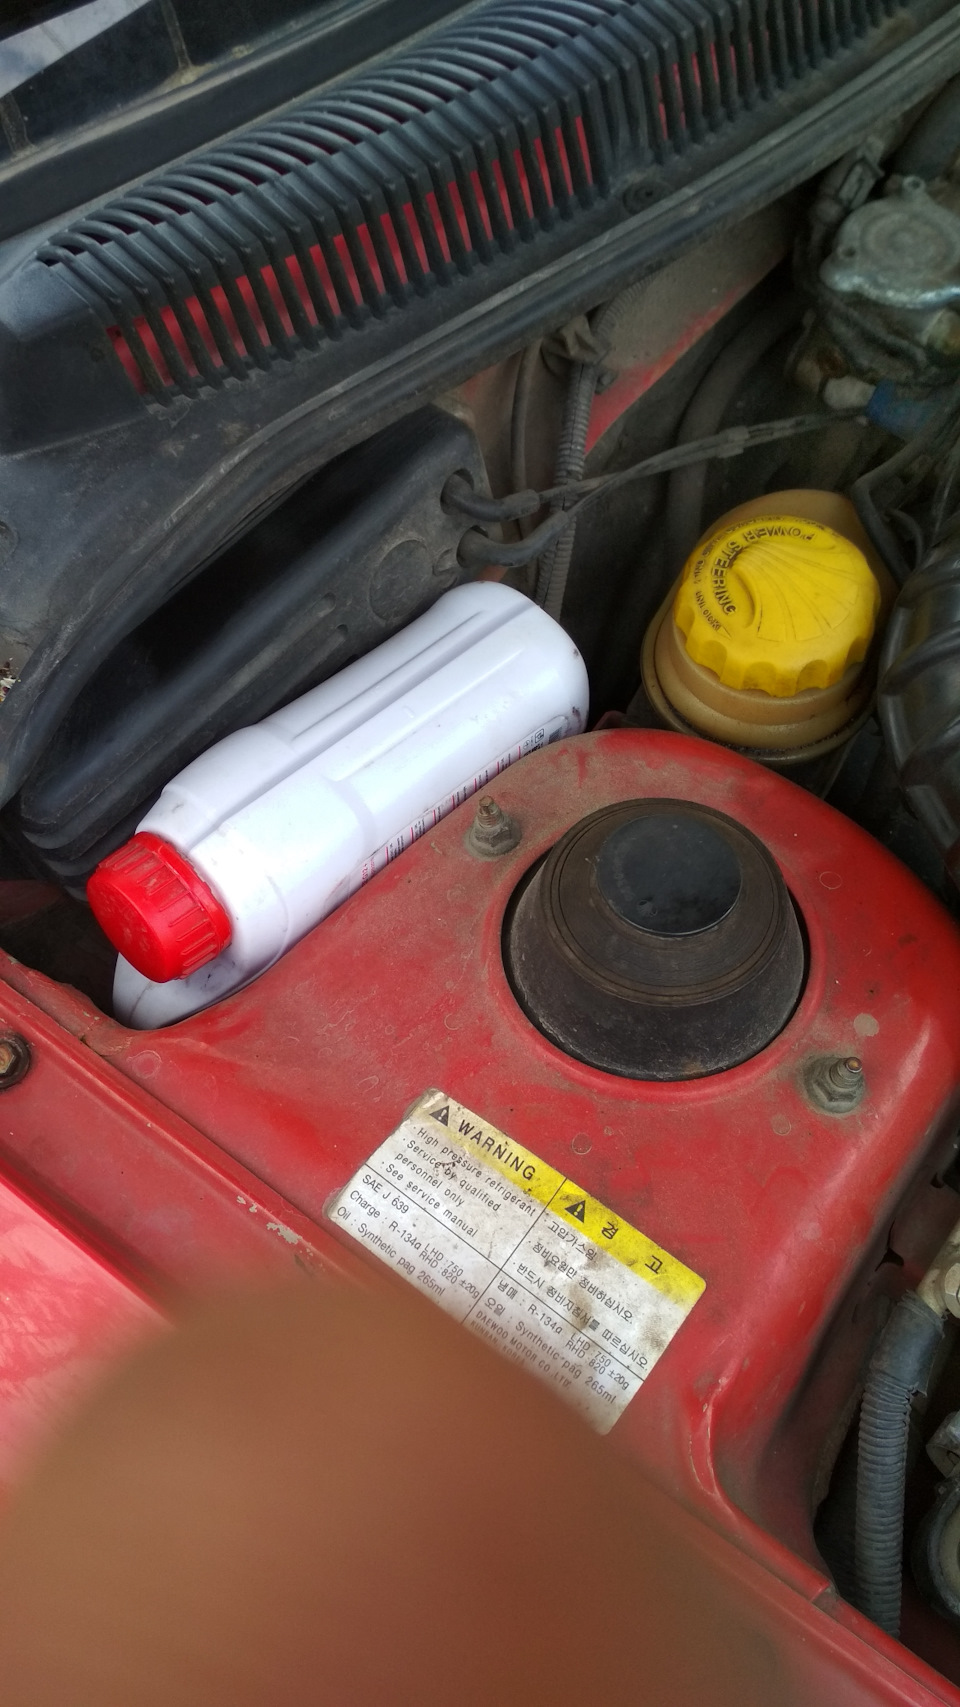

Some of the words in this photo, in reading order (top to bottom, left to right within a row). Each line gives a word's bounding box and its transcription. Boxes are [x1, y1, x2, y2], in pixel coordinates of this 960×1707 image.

[743, 526, 814, 541] POWER
[711, 541, 741, 616] STEERING
[407, 1140, 441, 1168] Service
[445, 1167, 455, 1180] by
[460, 1179, 500, 1211] qualified
[417, 1128, 439, 1148] High
[440, 1147, 482, 1177] pressure
[485, 1176, 536, 1216] refrigerant
[457, 1119, 537, 1180] WARNING
[362, 1174, 382, 1193] SAE
[383, 1190, 390, 1199] J
[391, 1196, 409, 1214] 639
[386, 1164, 404, 1181] See
[407, 1181, 440, 1209] service
[443, 1209, 478, 1237] manual
[395, 1153, 442, 1188] personnel
[444, 1188, 464, 1207] only
[350, 1190, 381, 1218] Charge
[389, 1221, 422, 1250] R-134a
[336, 1206, 350, 1220] Oil
[357, 1222, 397, 1258] Synthetic
[397, 1257, 415, 1275] pag
[417, 1270, 445, 1296] 265ml
[419, 1251, 438, 1268] RHD
[424, 1243, 444, 1261] LHD
[516, 1263, 545, 1288] 반드시
[476, 1311, 509, 1339] DAEWOO
[510, 1337, 537, 1361] MOTOR
[528, 1304, 563, 1334] R-134a
[571, 1333, 591, 1351] LHD
[515, 1321, 560, 1360] Synthetic
[562, 1360, 581, 1378] pag
[585, 1376, 616, 1403] 265ml
[565, 1341, 585, 1359] RHD
